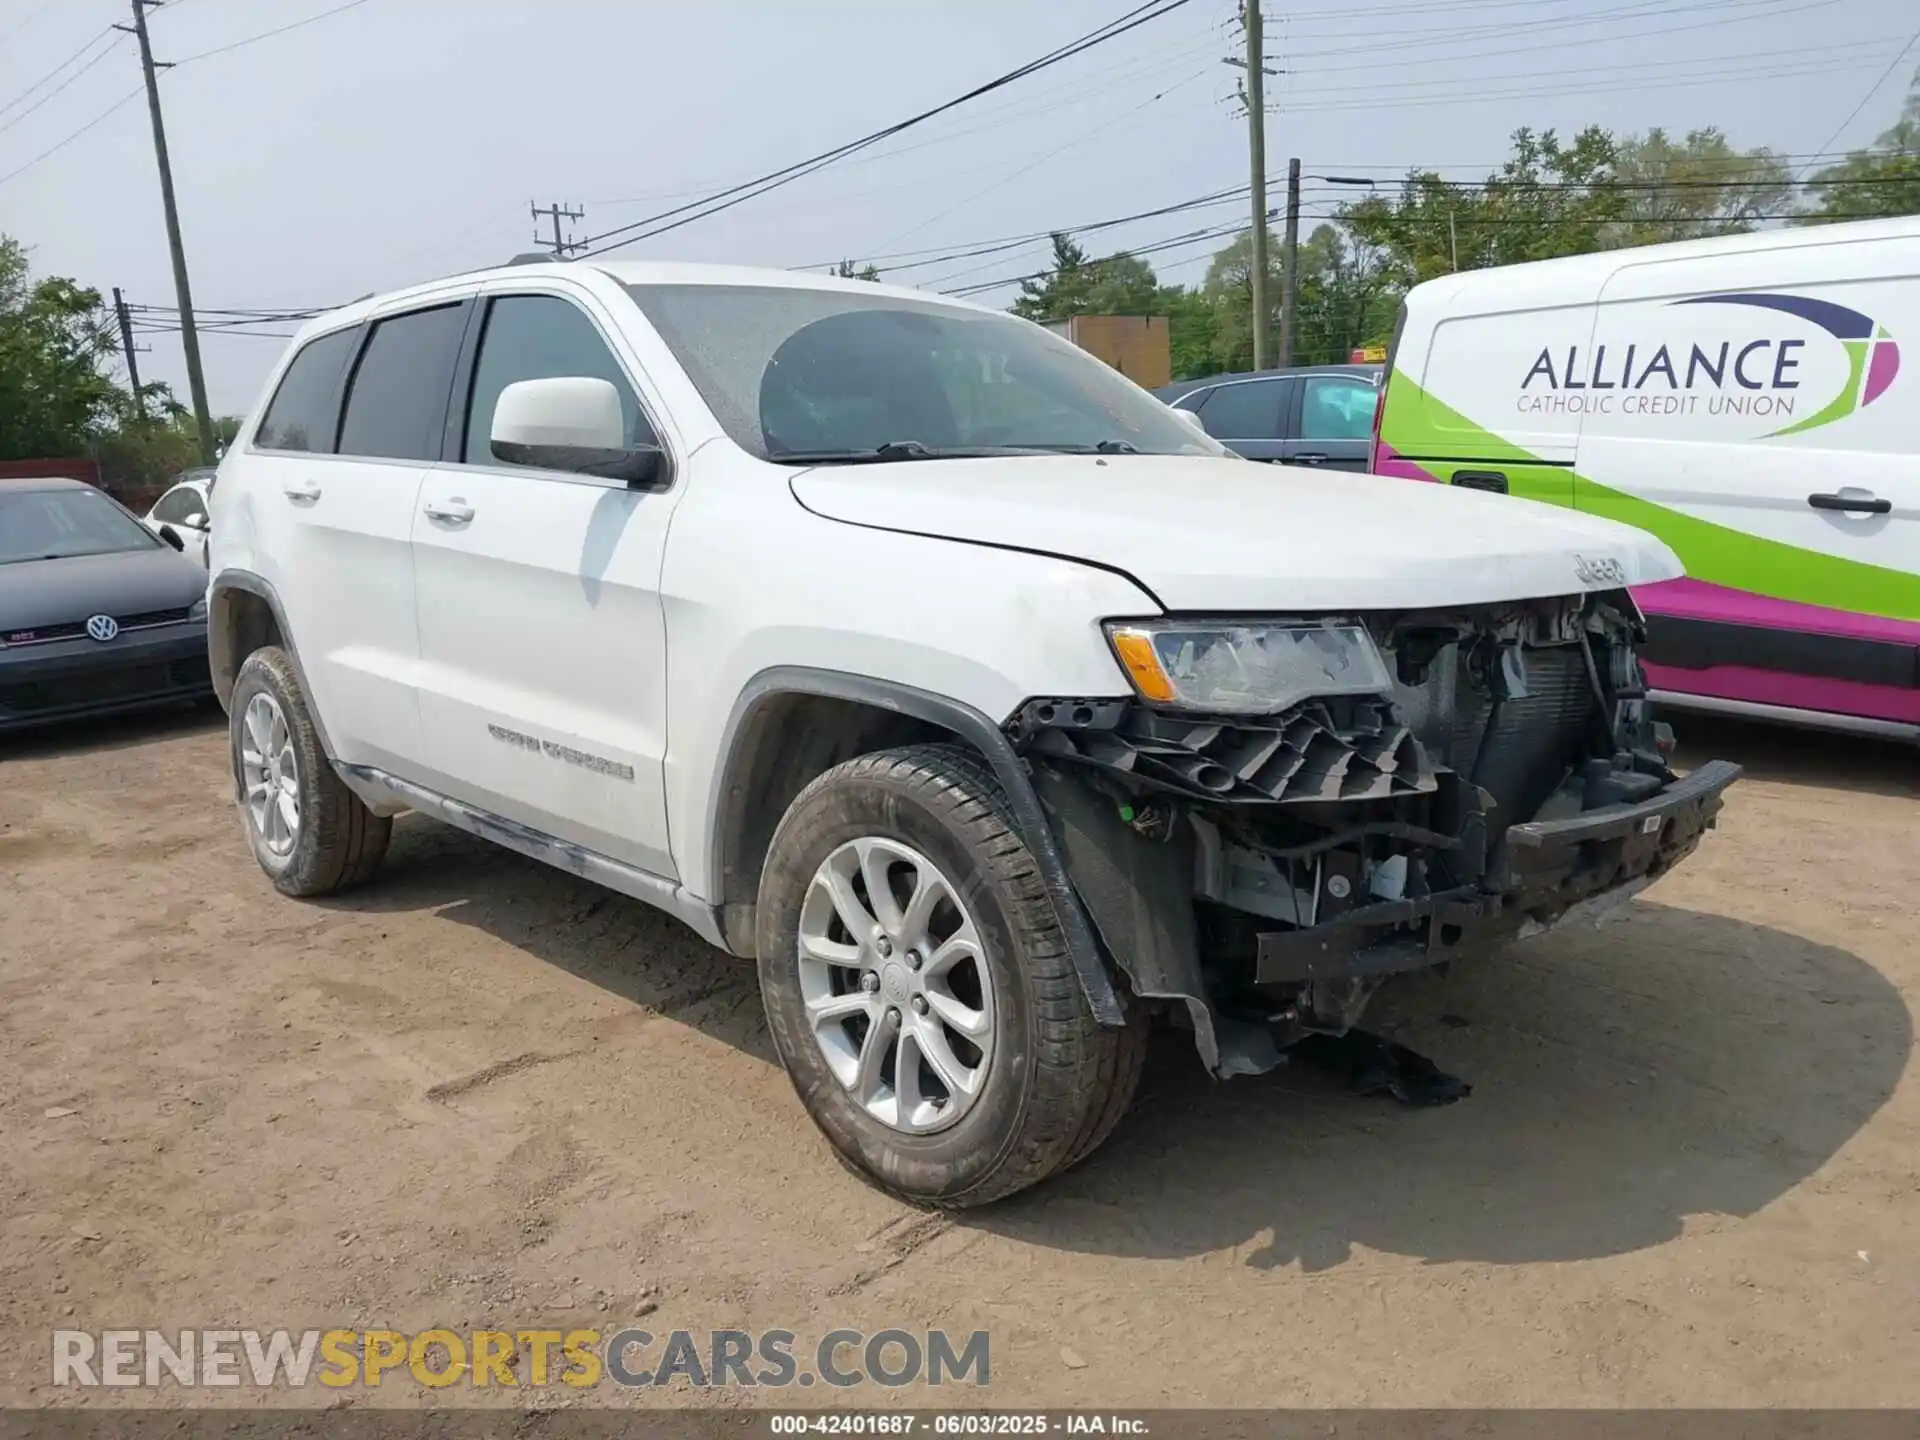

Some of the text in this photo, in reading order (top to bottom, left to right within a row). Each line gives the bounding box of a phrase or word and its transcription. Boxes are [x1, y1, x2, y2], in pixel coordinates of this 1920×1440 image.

[1521, 340, 1806, 390] ALLIANCE
[1516, 394, 1796, 416] CATHOLIC CREDIT UNION
